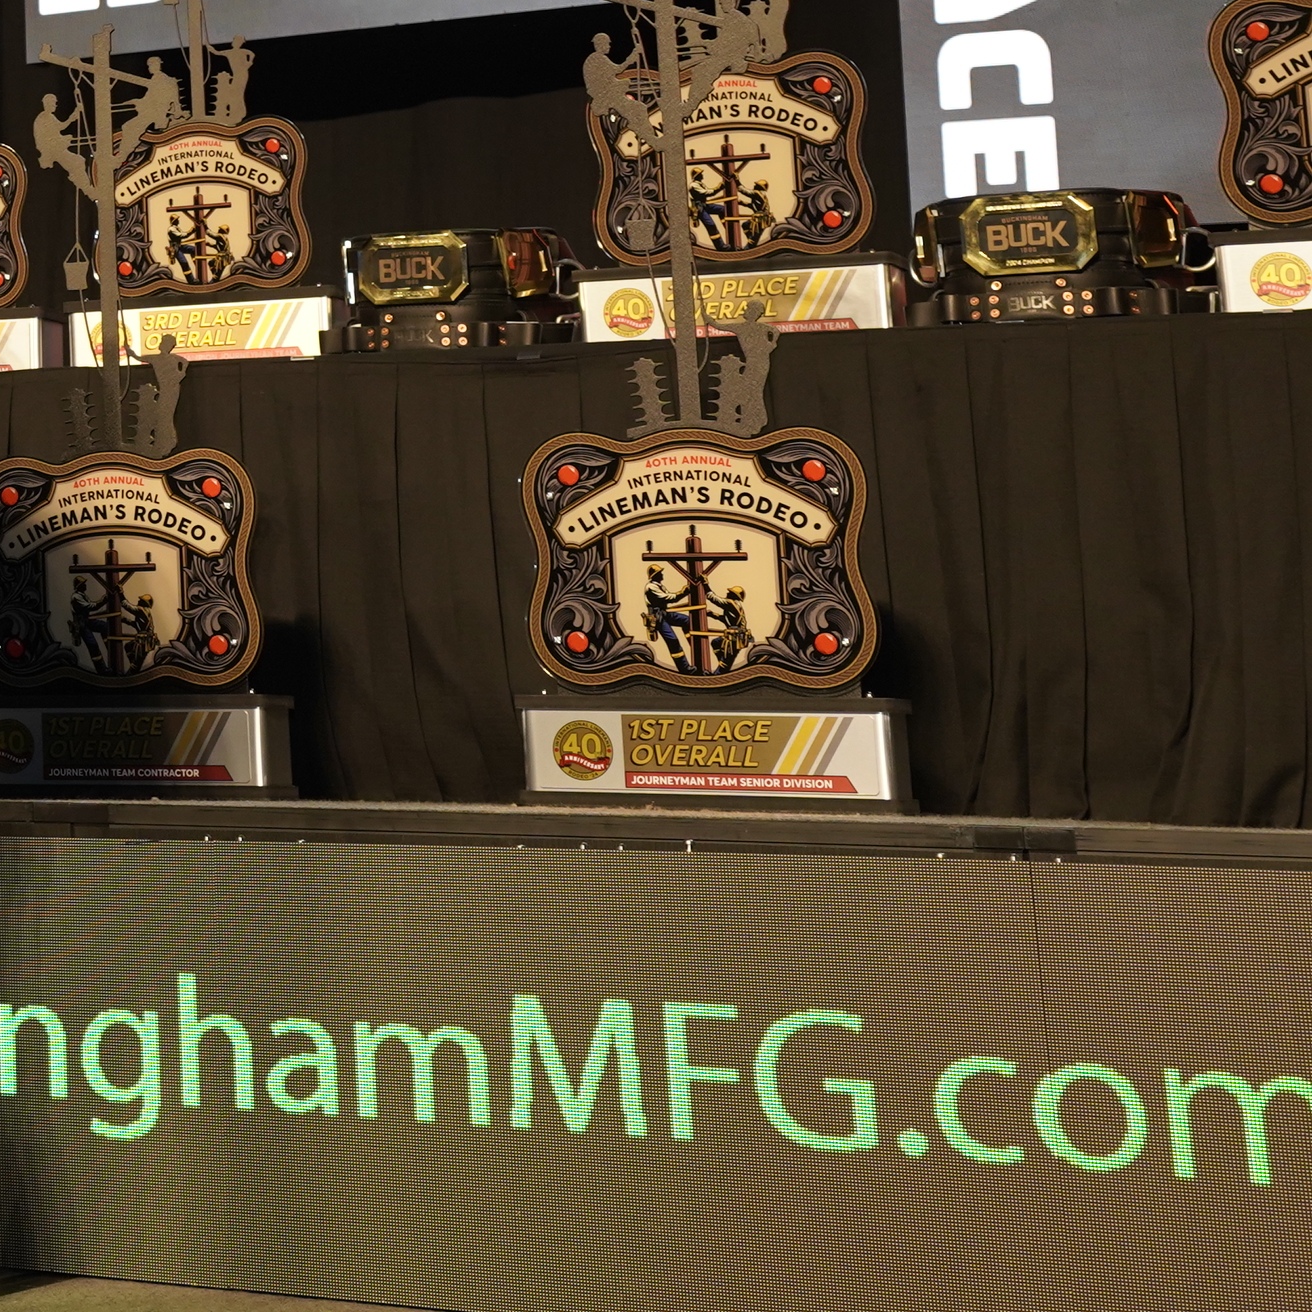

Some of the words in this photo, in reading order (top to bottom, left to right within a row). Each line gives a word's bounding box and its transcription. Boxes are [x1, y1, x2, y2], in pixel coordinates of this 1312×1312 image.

[717, 80, 758, 88] ANNUAL
[748, 104, 818, 132] RODEO
[169, 141, 190, 151] 40TH
[192, 140, 223, 148] ANNUAL
[157, 150, 235, 166] INTERNATIONAL
[127, 161, 209, 196] LINEMAN'S
[214, 162, 268, 185] RODEO
[986, 221, 1070, 252] BUCK
[378, 256, 445, 283] BUCK
[720, 276, 799, 298] PLACE
[143, 314, 182, 330] 3RD
[187, 308, 254, 328] PLACE
[776, 321, 821, 333] RNEYMAN
[824, 321, 850, 331] TEAM
[145, 329, 237, 350] OERALL
[645, 456, 678, 468] 40TH
[681, 456, 733, 467] ANNUAL
[73, 477, 100, 489] 40TH
[103, 476, 145, 486] ANNUAL
[627, 470, 752, 490] INTERNATIONAL
[58, 489, 160, 508] INTERNATIONAL
[577, 486, 711, 533] LINEMAN'S
[720, 487, 808, 529] RODEO
[17, 504, 126, 549] LINEMAN'S
[134, 505, 206, 541] RODEO
[49, 716, 85, 736] 1ST
[89, 716, 165, 737] PLACE
[628, 719, 675, 740] 1ST
[679, 719, 772, 743] PLACE
[49, 738, 154, 760] OVERALL
[631, 744, 759, 768] OVERALL
[48, 768, 110, 777] JOURNEYMAN
[111, 768, 136, 777] TEAM
[138, 768, 200, 778] CONTRACTOR
[631, 775, 707, 786] JOURNEYMAN
[707, 777, 738, 786] TEAM
[740, 777, 781, 788] SENIOR
[783, 778, 833, 789] DIVISION
